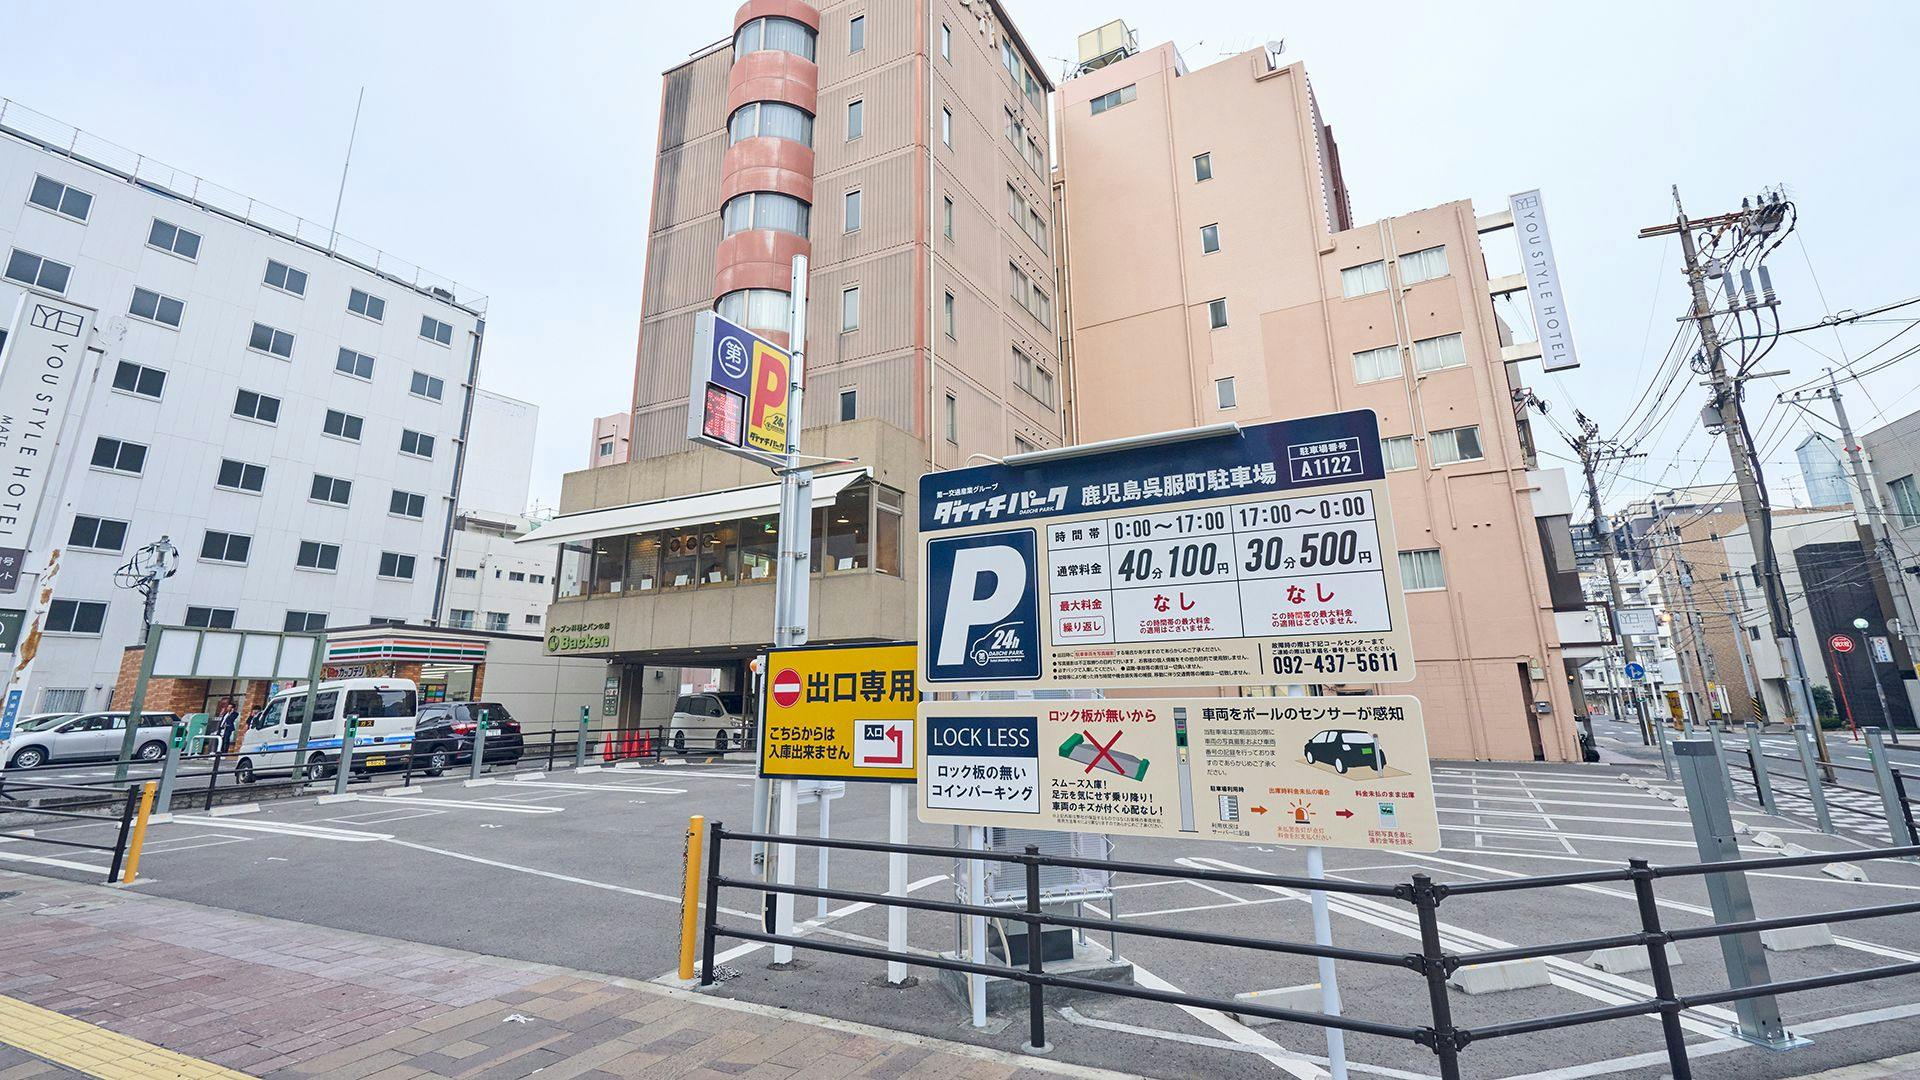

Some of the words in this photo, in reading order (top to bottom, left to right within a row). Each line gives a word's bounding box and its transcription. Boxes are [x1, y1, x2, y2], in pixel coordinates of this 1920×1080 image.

[1523, 211, 1542, 245] YOU
[1531, 250, 1553, 299] STYLE
[1544, 306, 1566, 361] HOTEL
[41, 343, 69, 385] YOU
[752, 352, 787, 429] P
[19, 393, 53, 457] STYLE
[1300, 441, 1348, 456] 駐車場番号
[1301, 455, 1352, 477] A1122
[1082, 462, 1277, 506] 鹿児島呉服町駐車場
[1055, 527, 1100, 542] 時間帯
[1056, 563, 1102, 577] 通常料金
[1153, 592, 1195, 612] なし
[1286, 582, 1335, 605] なし
[937, 545, 1027, 666] P
[1059, 599, 1102, 612] 最大料金
[1139, 617, 1210, 628] この時間帯の最大料金
[1271, 609, 1353, 620] この時間帯の最大料金
[1063, 621, 1101, 633] 繰り返し
[560, 634, 609, 650] Backen
[991, 629, 1020, 650] 24h
[1273, 652, 1398, 675] 092-437-5611
[806, 670, 915, 703] 出口専用
[1049, 709, 1157, 723] ロック板が無いから
[1202, 707, 1404, 721] 車両をポールのセンサーが感知
[769, 726, 835, 741] こちらからは
[866, 727, 883, 738] 入口
[933, 727, 982, 747] LOCK
[987, 727, 1030, 748] LESS
[769, 744, 850, 760] 入庫出来ません
[937, 765, 1027, 781] ロック板の無い
[932, 784, 1033, 802] コインパーキング
[1051, 790, 1153, 804] 足元を気にせず乗り降り！
[1051, 802, 1163, 816] 車両のキズが付く心配なし！
